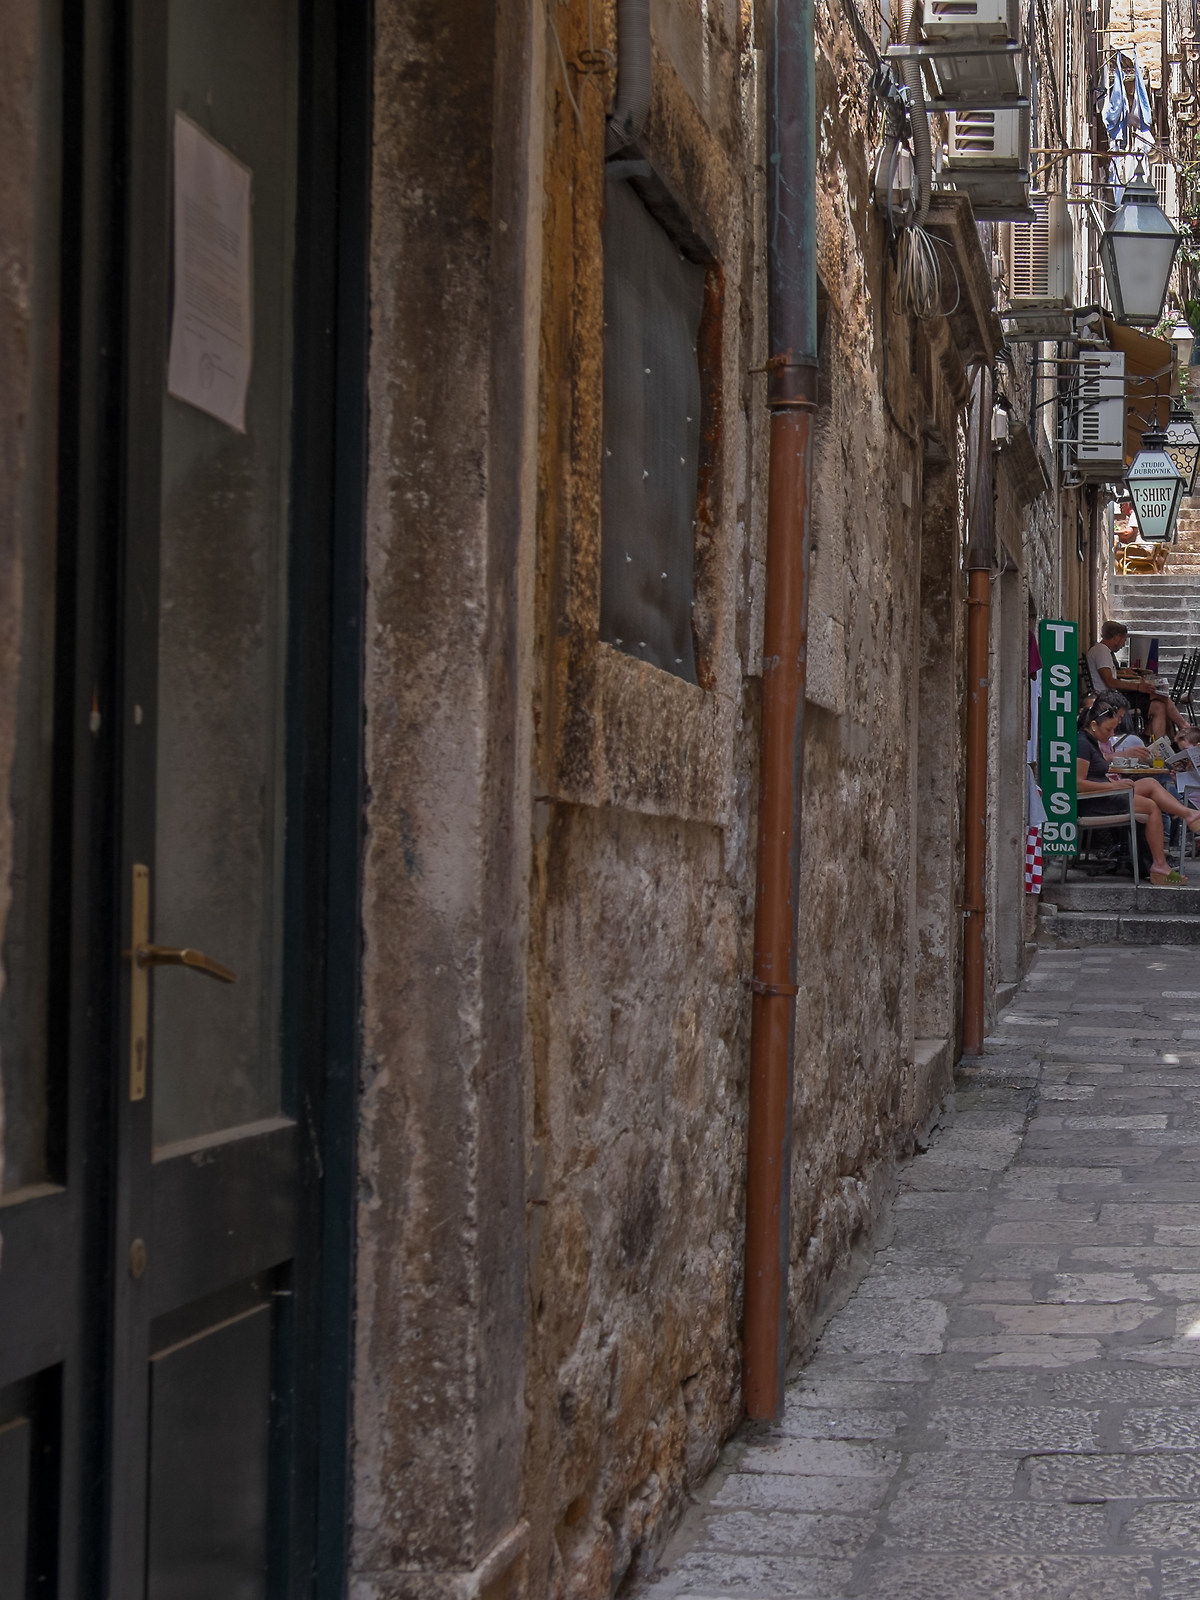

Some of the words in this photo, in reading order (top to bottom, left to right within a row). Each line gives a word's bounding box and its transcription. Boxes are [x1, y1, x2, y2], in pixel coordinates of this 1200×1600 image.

[1140, 461, 1165, 469] STUDIO
[1133, 487, 1172, 502] T-SHIRT
[1141, 503, 1167, 518] SHOP
[1042, 822, 1077, 842] 50
[1043, 843, 1076, 852] KUNA
